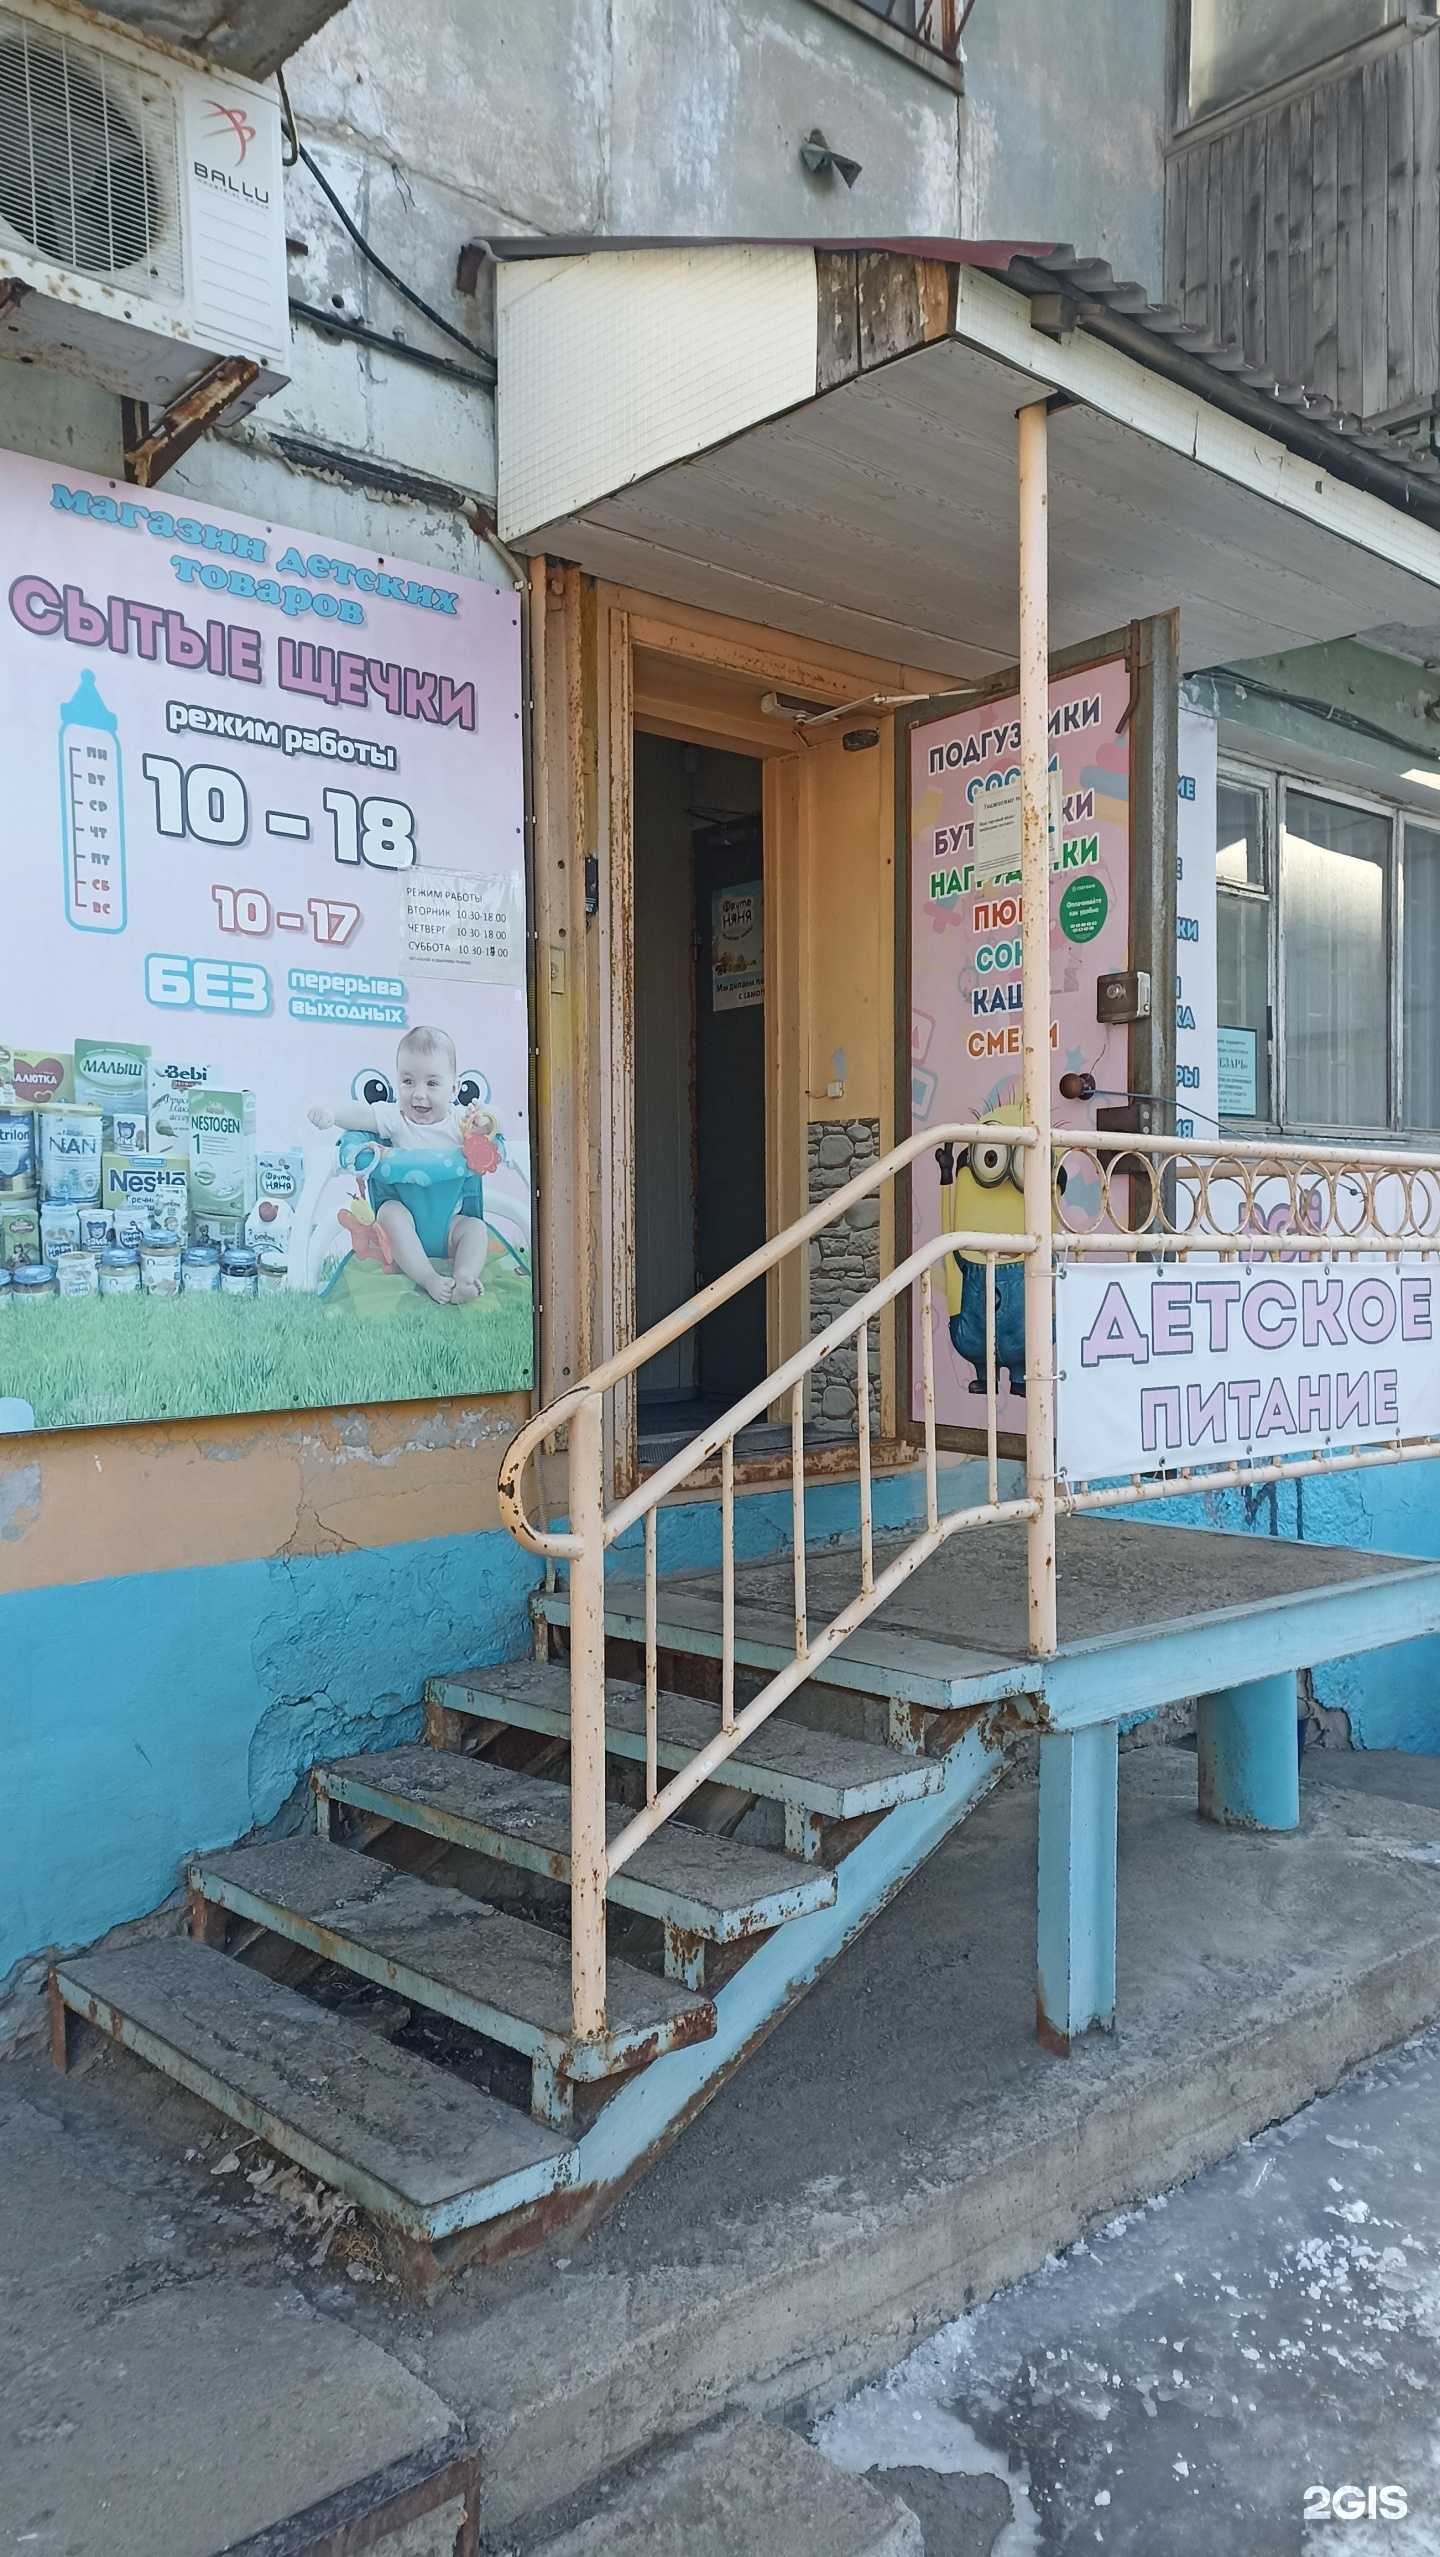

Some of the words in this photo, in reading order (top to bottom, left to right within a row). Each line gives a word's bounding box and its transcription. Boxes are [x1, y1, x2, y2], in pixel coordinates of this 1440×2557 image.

[193, 161, 269, 204] BALLU
[8, 574, 263, 685] СЫТЫЕ
[278, 636, 476, 731] ЩЕЧКИ
[166, 700, 281, 747] режим
[282, 726, 398, 772] работы
[928, 695, 1101, 774] ПОДГУЗИКИ
[406, 887, 443, 899] РЕЖИМ
[445, 890, 483, 904] РАБОТЫ
[407, 904, 451, 917] ВТОРНИК
[407, 923, 446, 935] ЧЕТВЕРГ
[408, 940, 451, 953] СУББОТА
[144, 952, 270, 1012] БЕЗ
[288, 968, 406, 998] перерыва
[289, 997, 406, 1026] выходных
[83, 1059, 143, 1077] МАЛЫШ
[14, 1073, 58, 1086] АЛЮТКА
[0, 1128, 30, 1142] trilon
[191, 1115, 241, 1134] NESTOGEN
[49, 1136, 97, 1155] NAN
[192, 1133, 201, 1155] 1
[1081, 1278, 1433, 1368] ДЕТСКОЕ
[1141, 1369, 1399, 1452] ПИТАНИЕ
